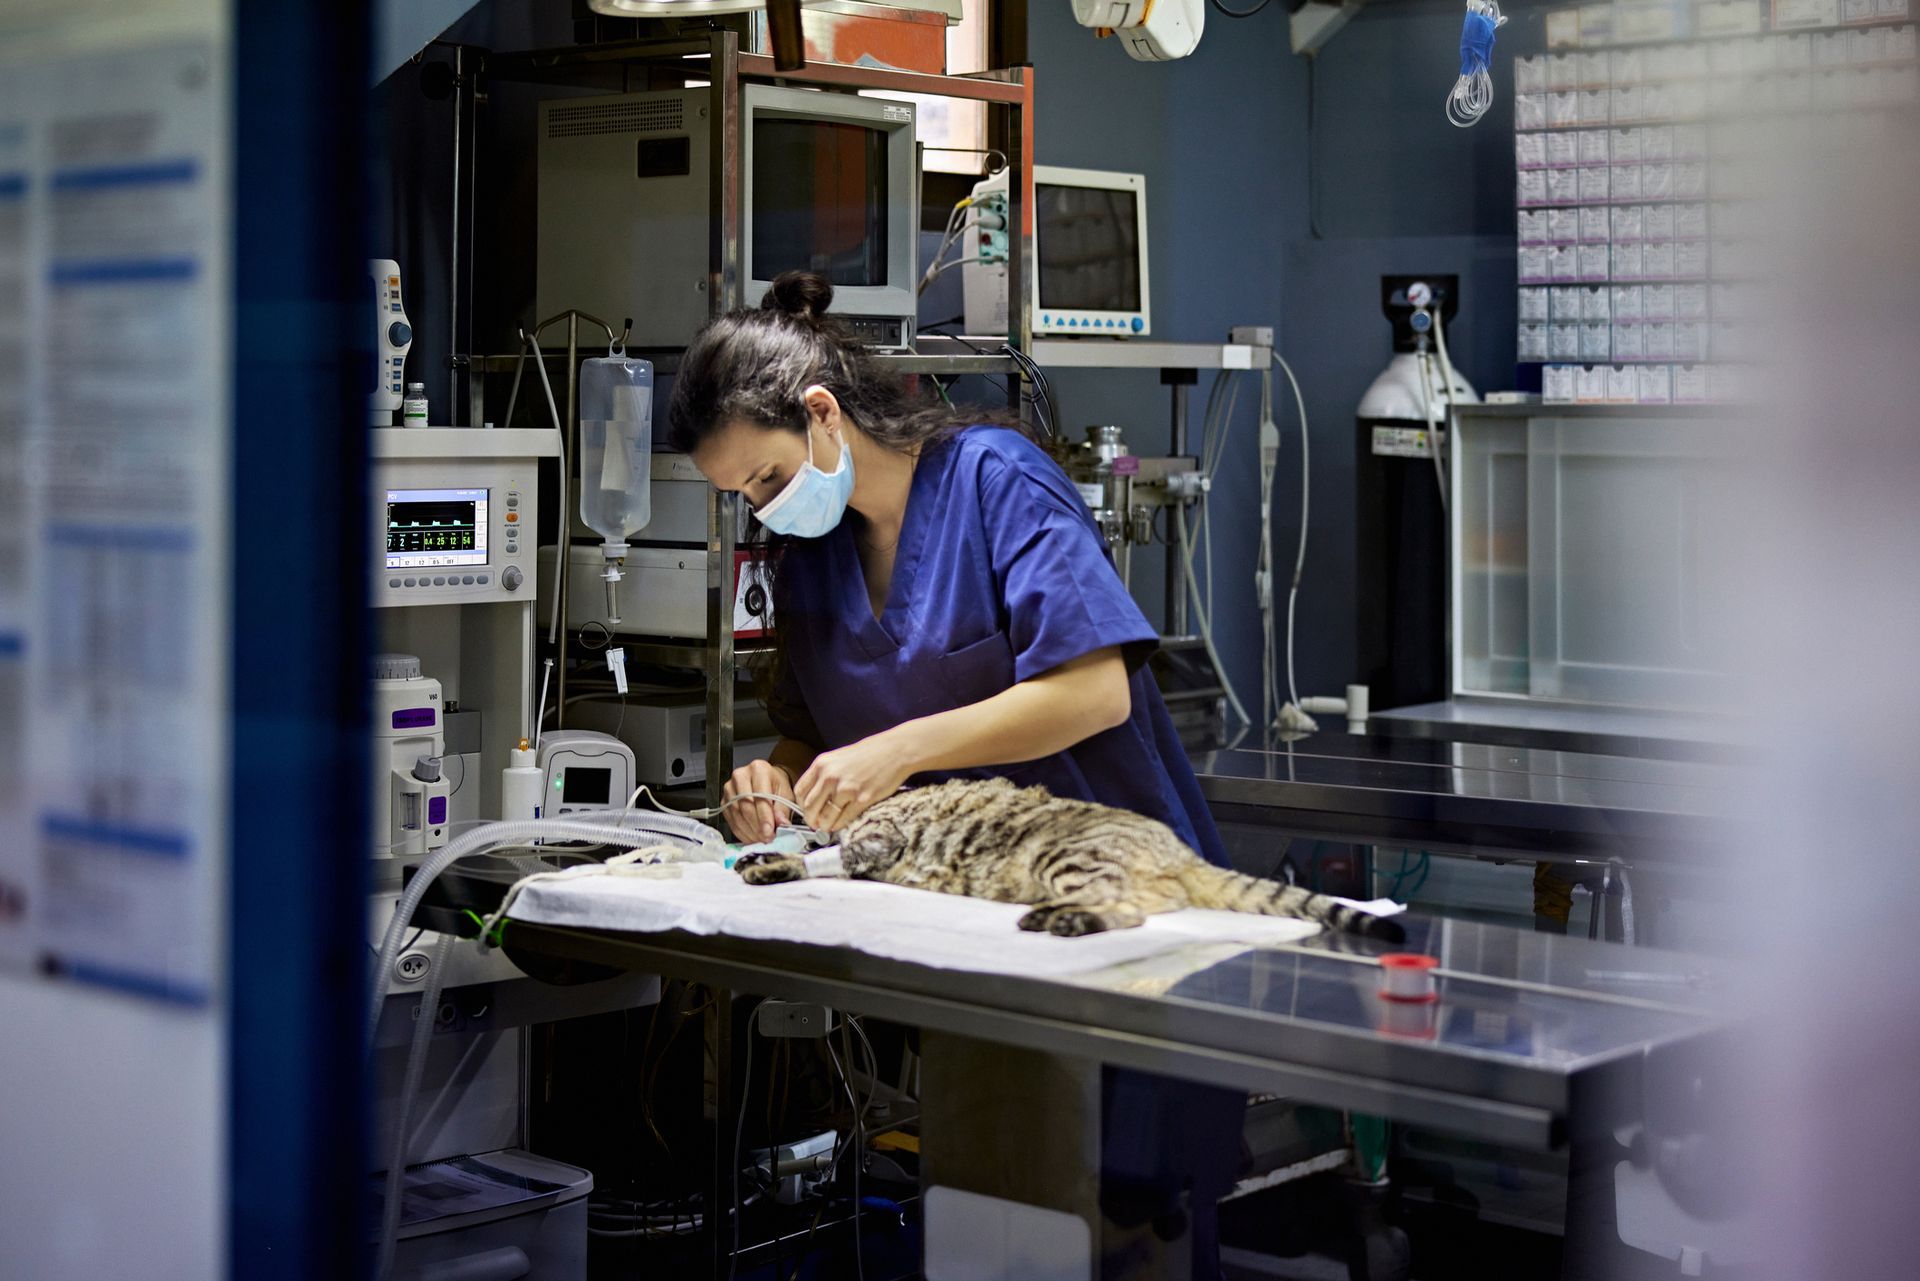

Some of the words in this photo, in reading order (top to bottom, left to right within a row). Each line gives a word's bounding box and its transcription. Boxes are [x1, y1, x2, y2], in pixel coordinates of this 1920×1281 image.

[437, 537, 445, 545] 25
[450, 537, 457, 545] 12
[463, 536, 471, 545] 54
